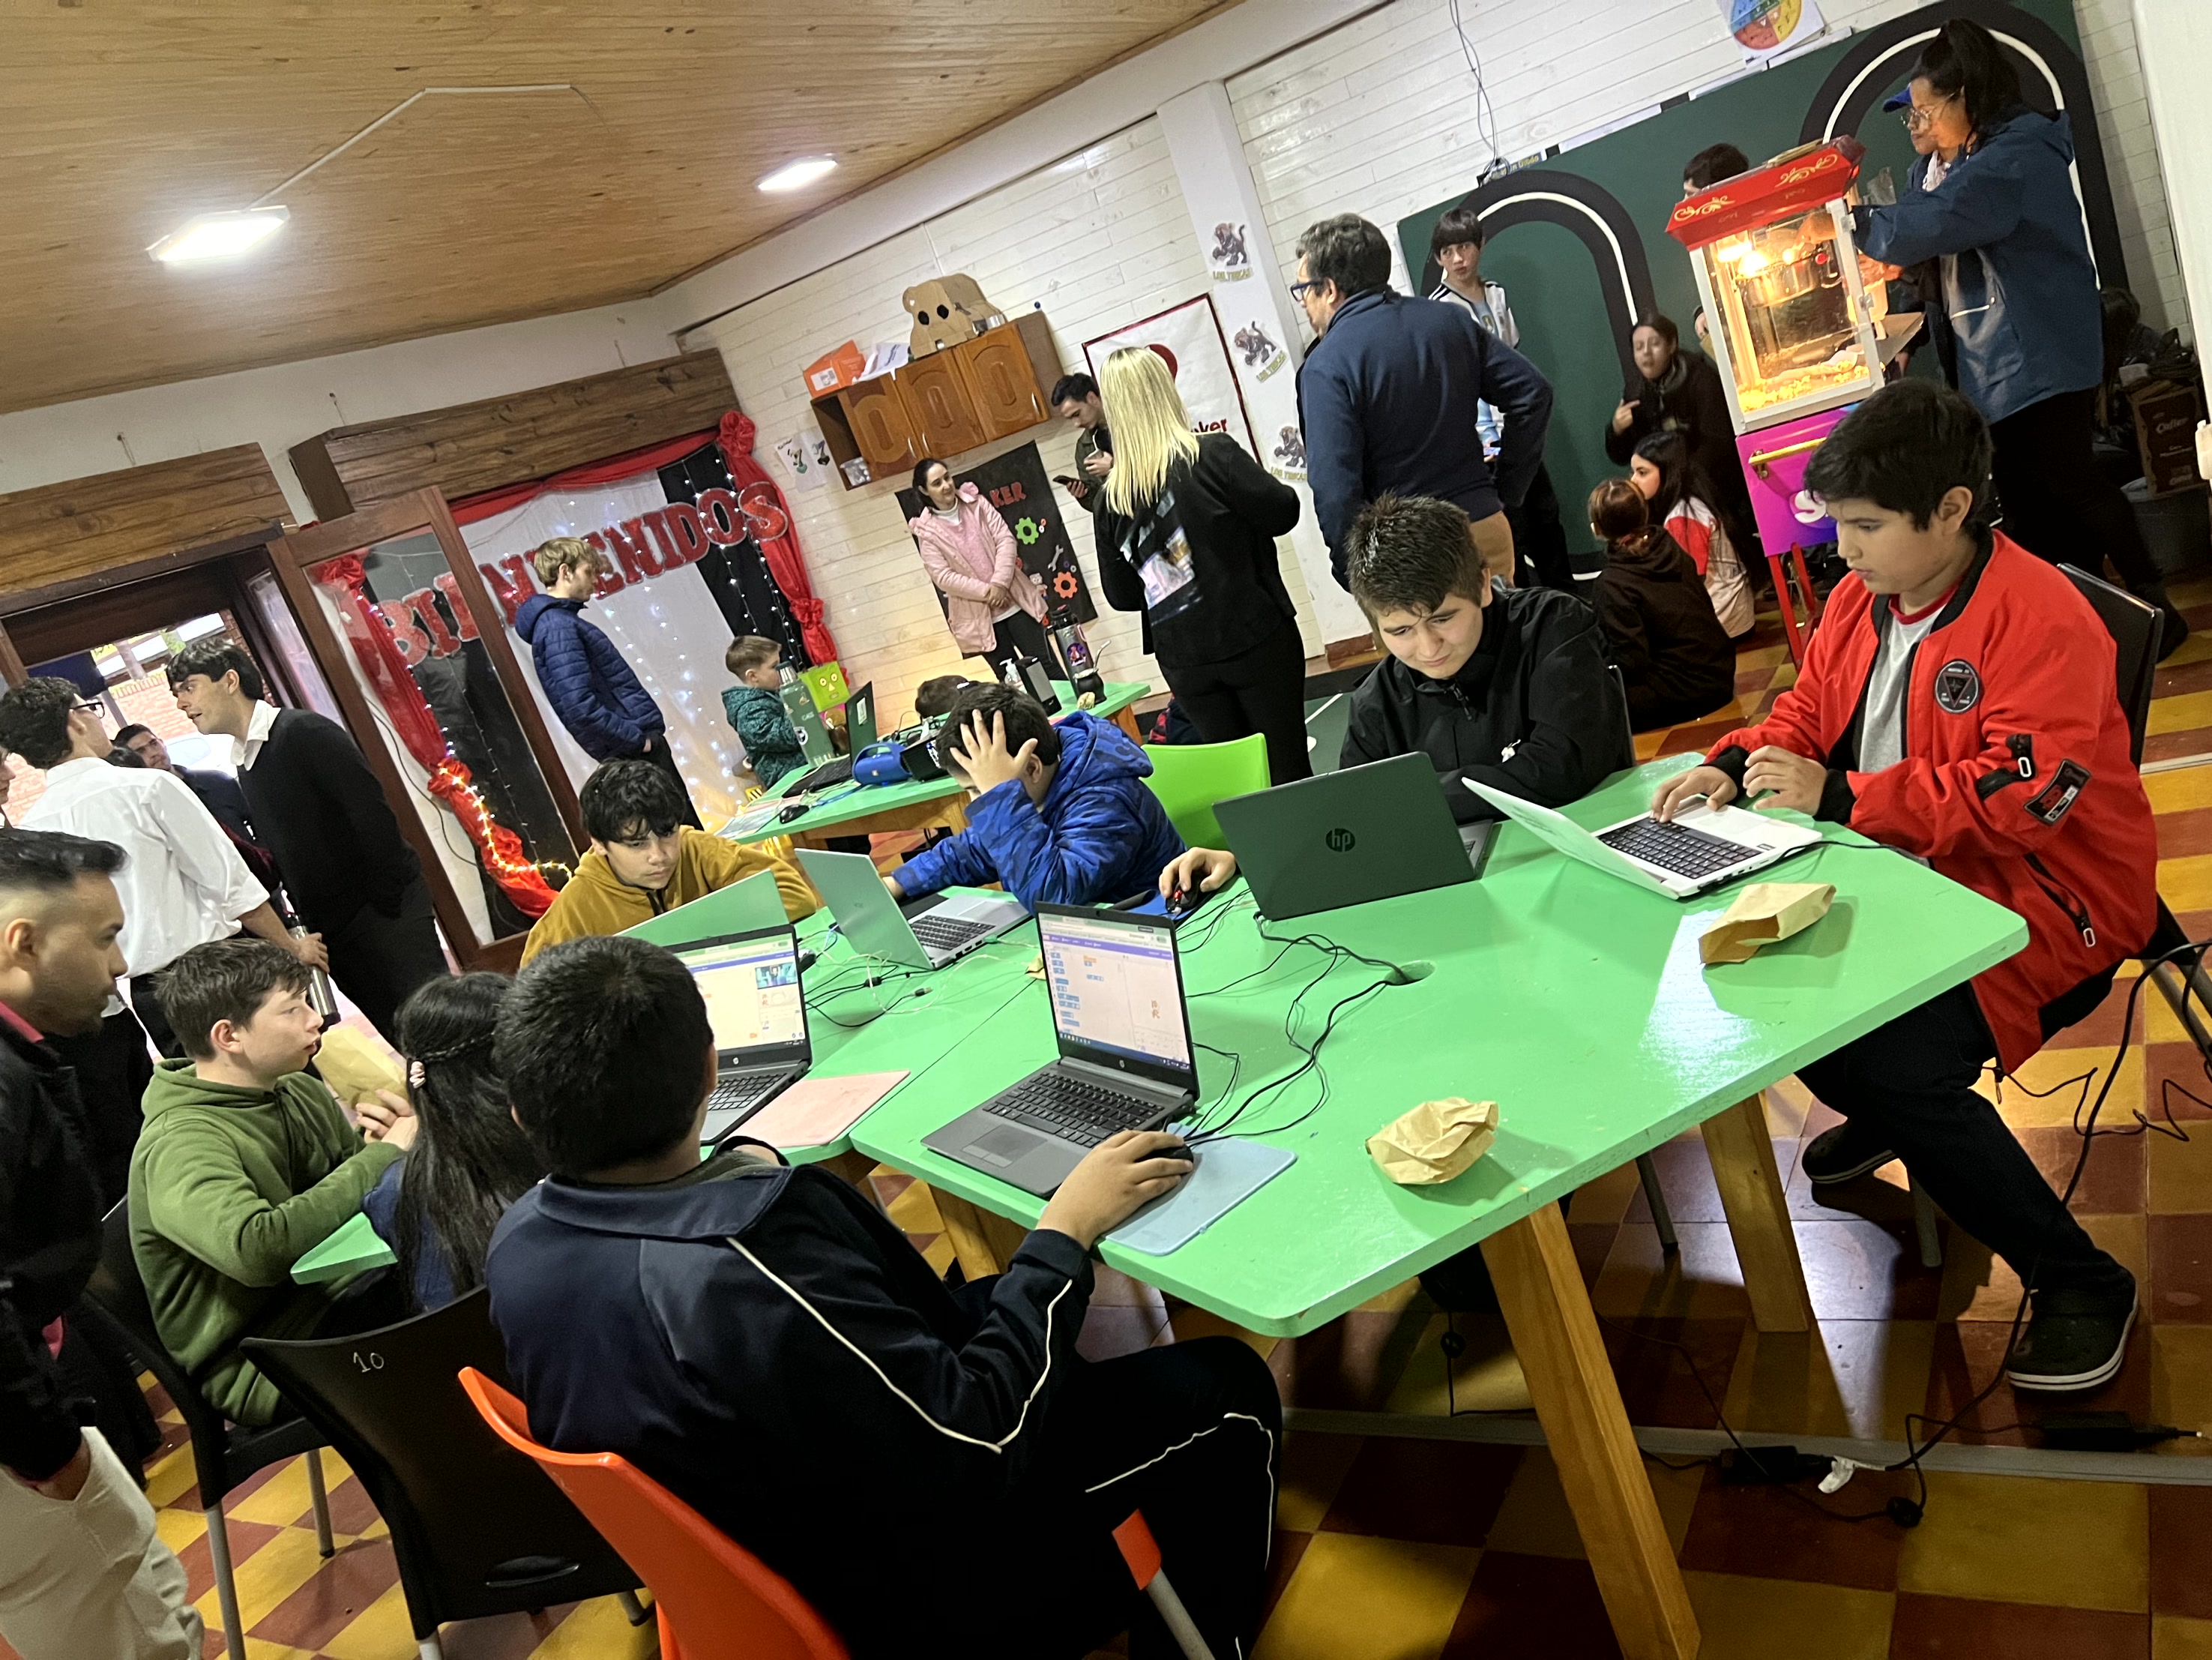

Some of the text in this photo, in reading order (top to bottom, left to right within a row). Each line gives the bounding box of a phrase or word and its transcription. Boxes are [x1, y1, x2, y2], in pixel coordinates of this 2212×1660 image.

[1191, 418, 1227, 433] ker
[1330, 828, 1353, 852] hp
[353, 1351, 385, 1373] 10
